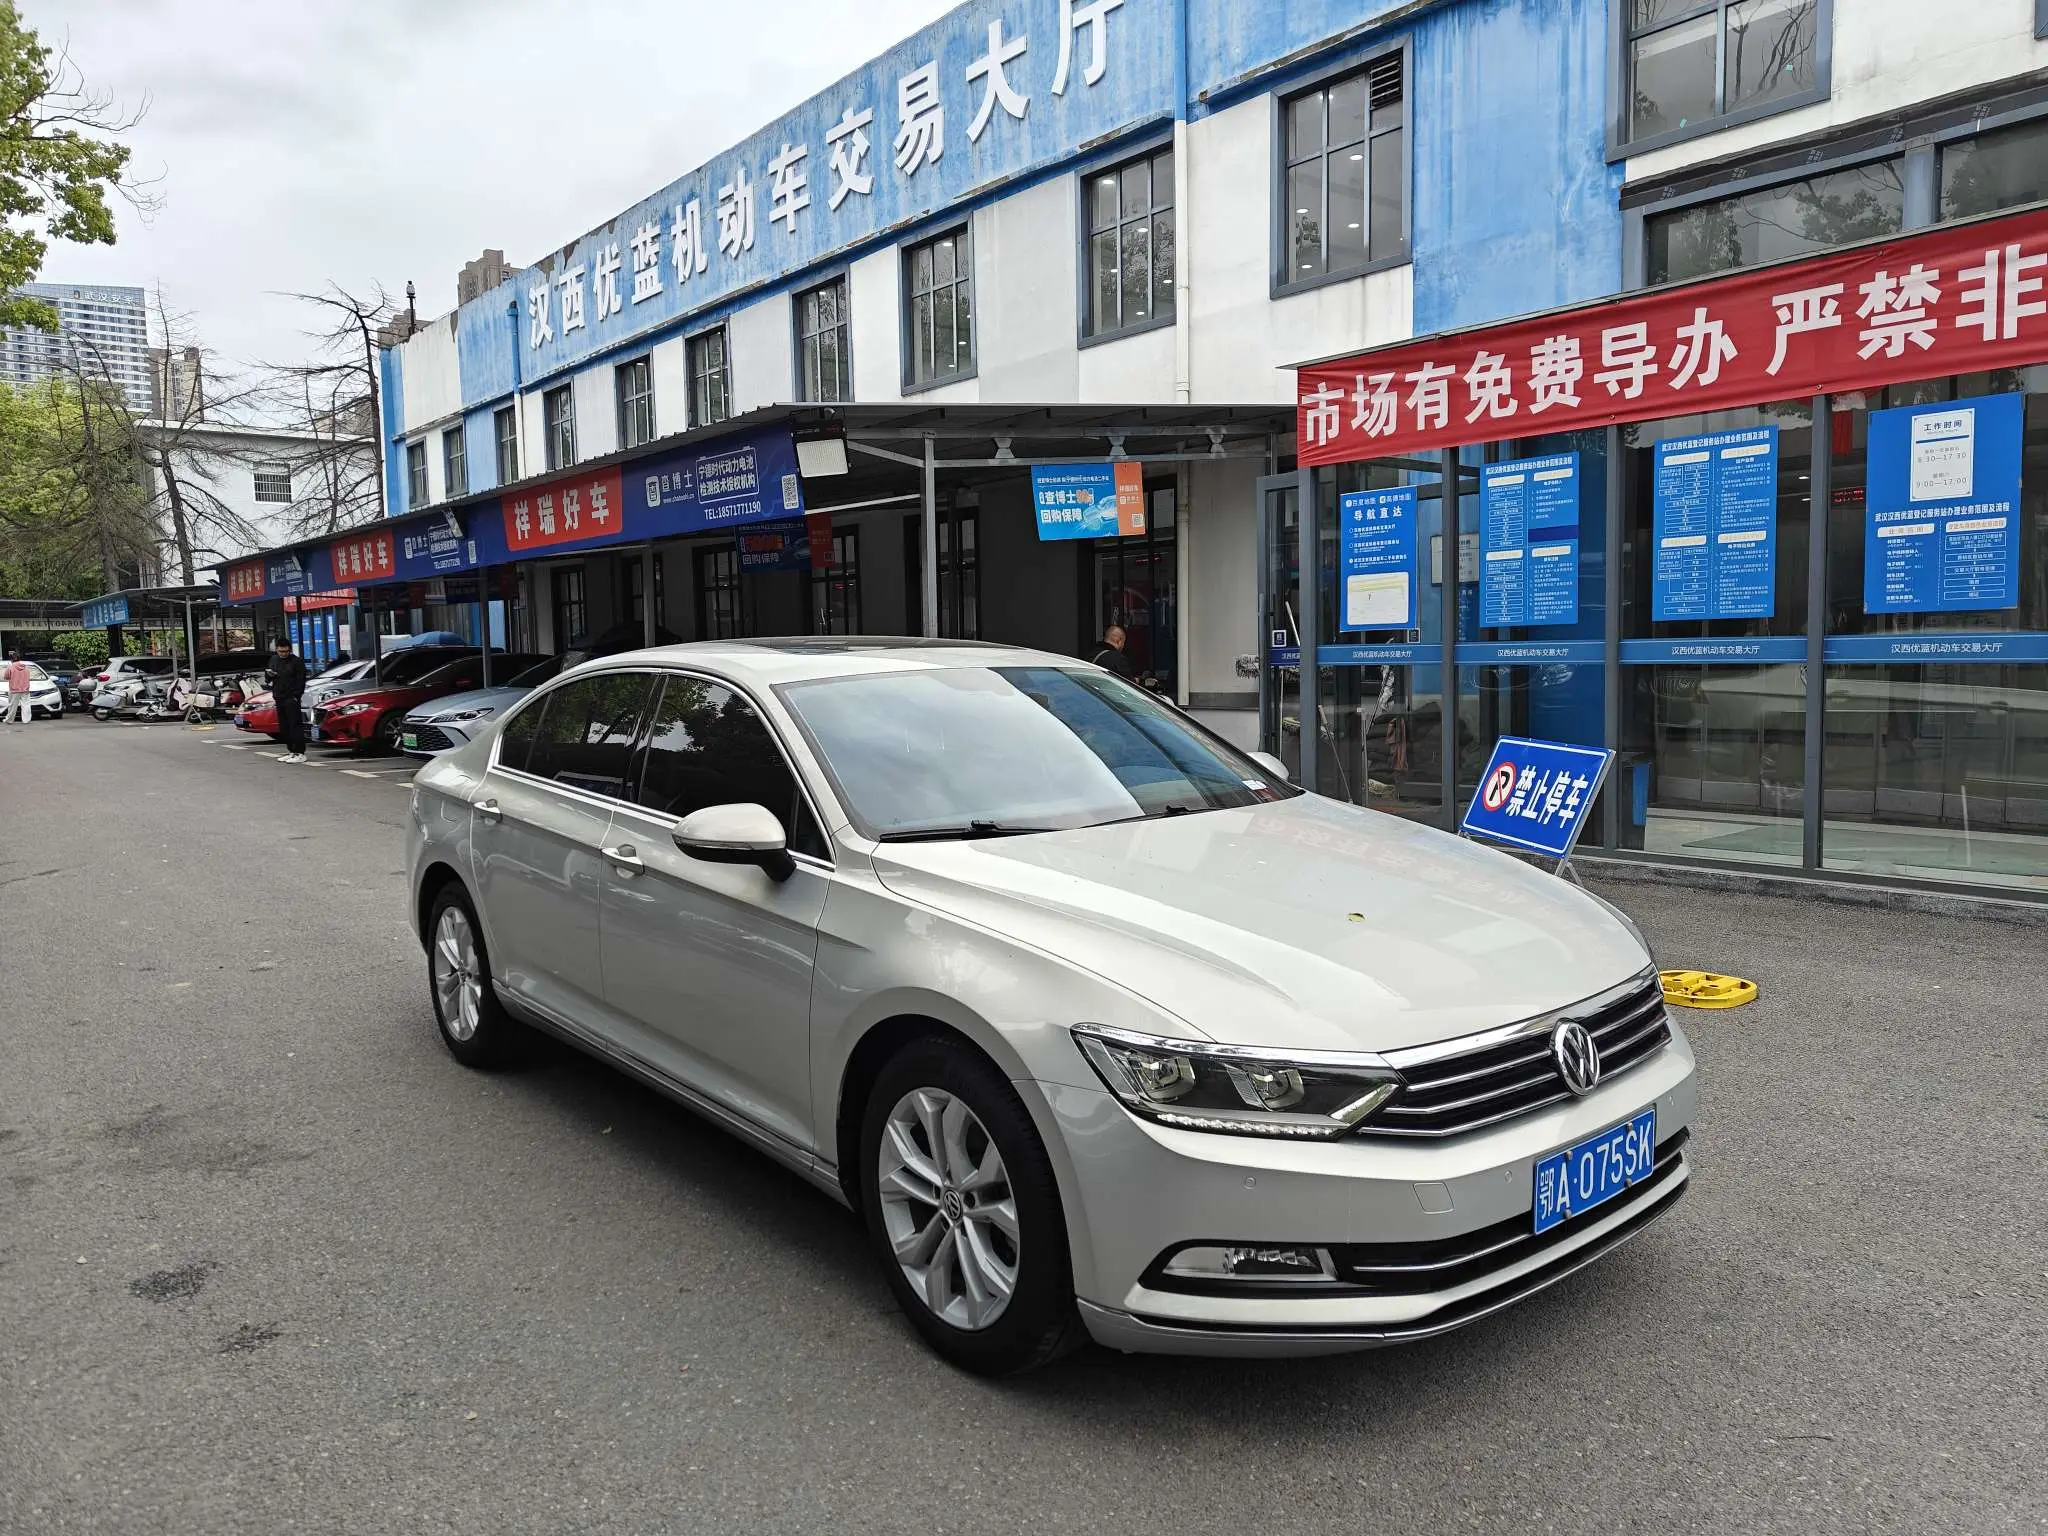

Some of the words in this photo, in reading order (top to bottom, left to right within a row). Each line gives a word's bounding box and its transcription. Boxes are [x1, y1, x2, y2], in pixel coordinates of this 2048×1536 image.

[527, 0, 1125, 350] 汉西优蓝机动车交易大厅
[1300, 307, 1738, 446] 市场有免费导办
[1765, 243, 2048, 376] 严禁非
[1923, 419, 1963, 432] 工作时间
[699, 455, 755, 480] 宁德时代动力电池
[661, 470, 693, 492] 查博士
[700, 473, 756, 496] 检测技术授权机构
[1045, 490, 1076, 505] 查博士
[514, 481, 610, 541] 祥瑞好车
[704, 501, 761, 520] TEL:18571771190
[1041, 508, 1083, 524] 回购保障
[1353, 505, 1403, 521] 导航直达
[1874, 501, 2010, 522] 武汉汉西优蓝登记服务站办理业务范围及流程
[337, 538, 389, 577] 祥瑞好车
[1497, 648, 1569, 658] 汉西优蓝机动车交易大厅
[1671, 645, 1760, 656] 汉西优蓝机动车交易大厅
[1891, 642, 2003, 654] 汉西优蓝机动车交易大厅
[1506, 765, 1589, 829] 禁止停车
